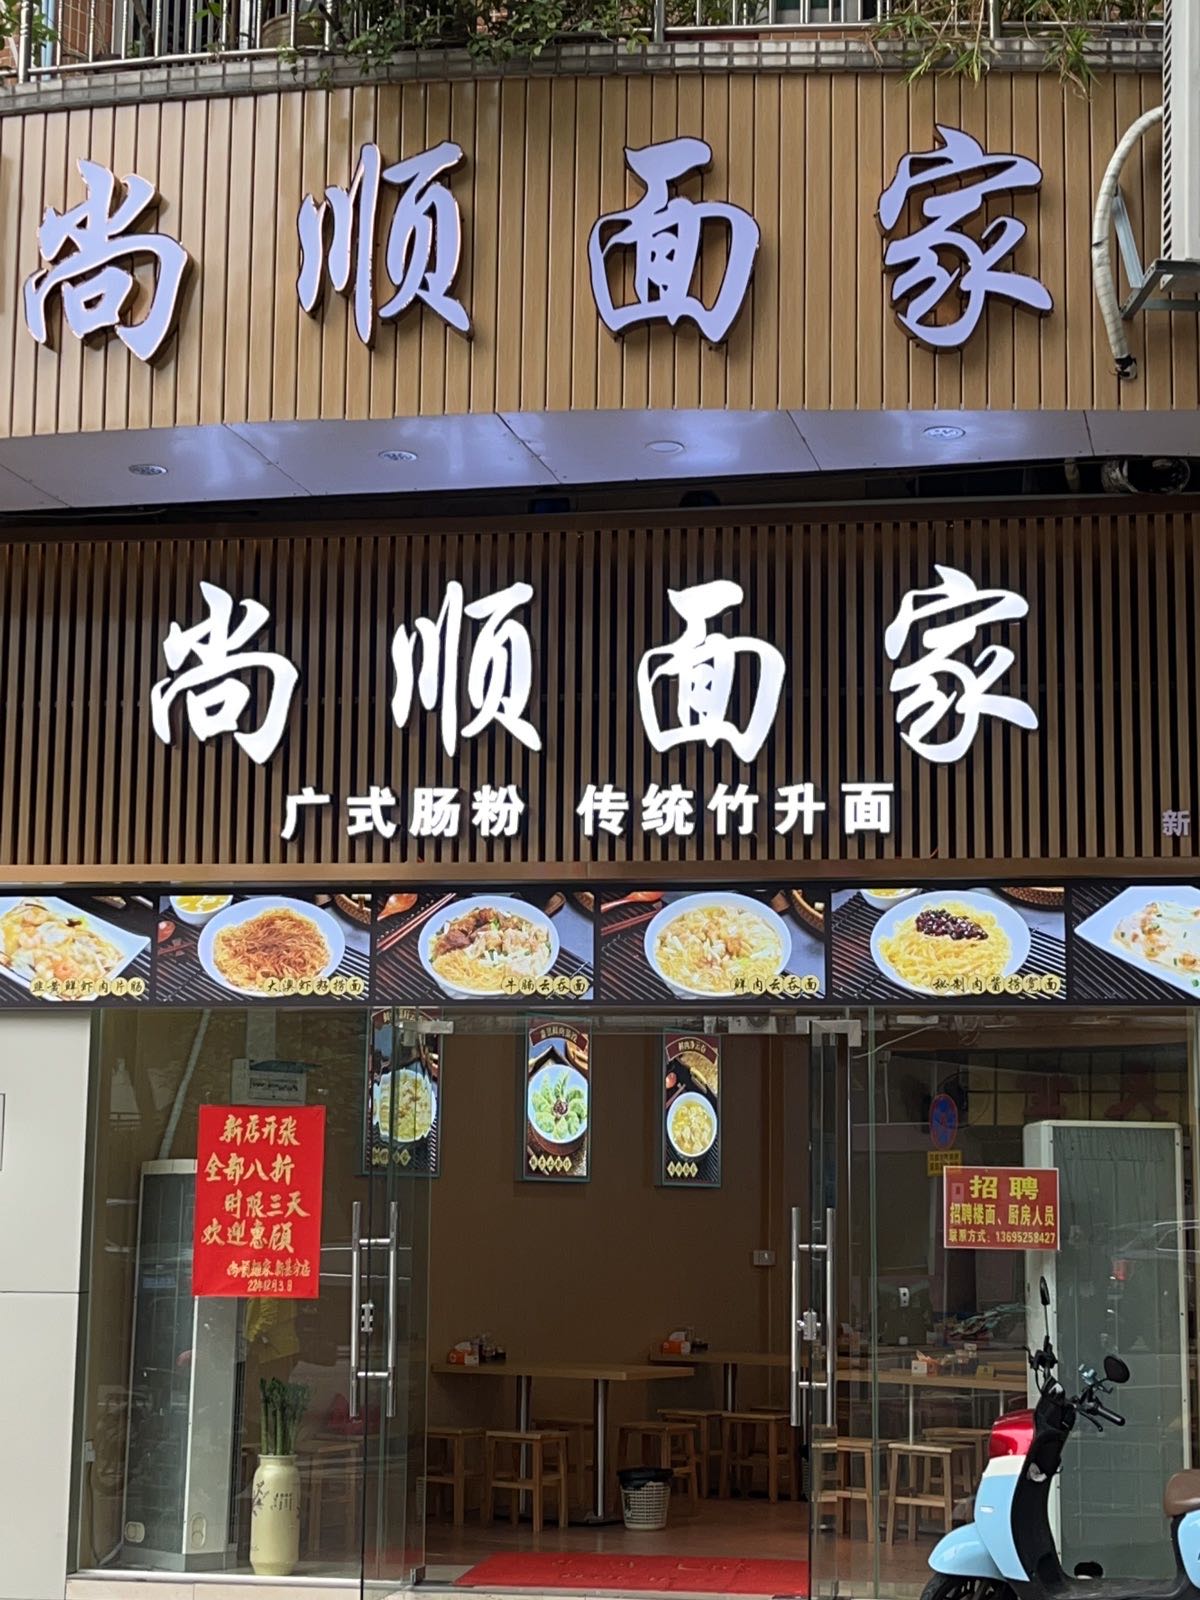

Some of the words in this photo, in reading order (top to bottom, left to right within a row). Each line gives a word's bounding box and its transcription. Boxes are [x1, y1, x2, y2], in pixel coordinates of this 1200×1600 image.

[24, 124, 1053, 364] 尚顺面家
[151, 564, 1040, 765] 尚顺面家
[280, 785, 526, 840] 广式肠粉
[576, 782, 896, 837] 传统竹升面
[1162, 809, 1190, 837] 新
[505, 977, 586, 993] 牛腩云吞面
[733, 977, 818, 992] 鲜肉云吞面
[219, 1114, 300, 1147] 新店开张
[204, 1151, 295, 1186] 全部八折
[224, 1188, 311, 1219] 时限三天
[969, 1175, 1039, 1200] 招聘
[200, 1217, 294, 1253] 欢迎惠顾
